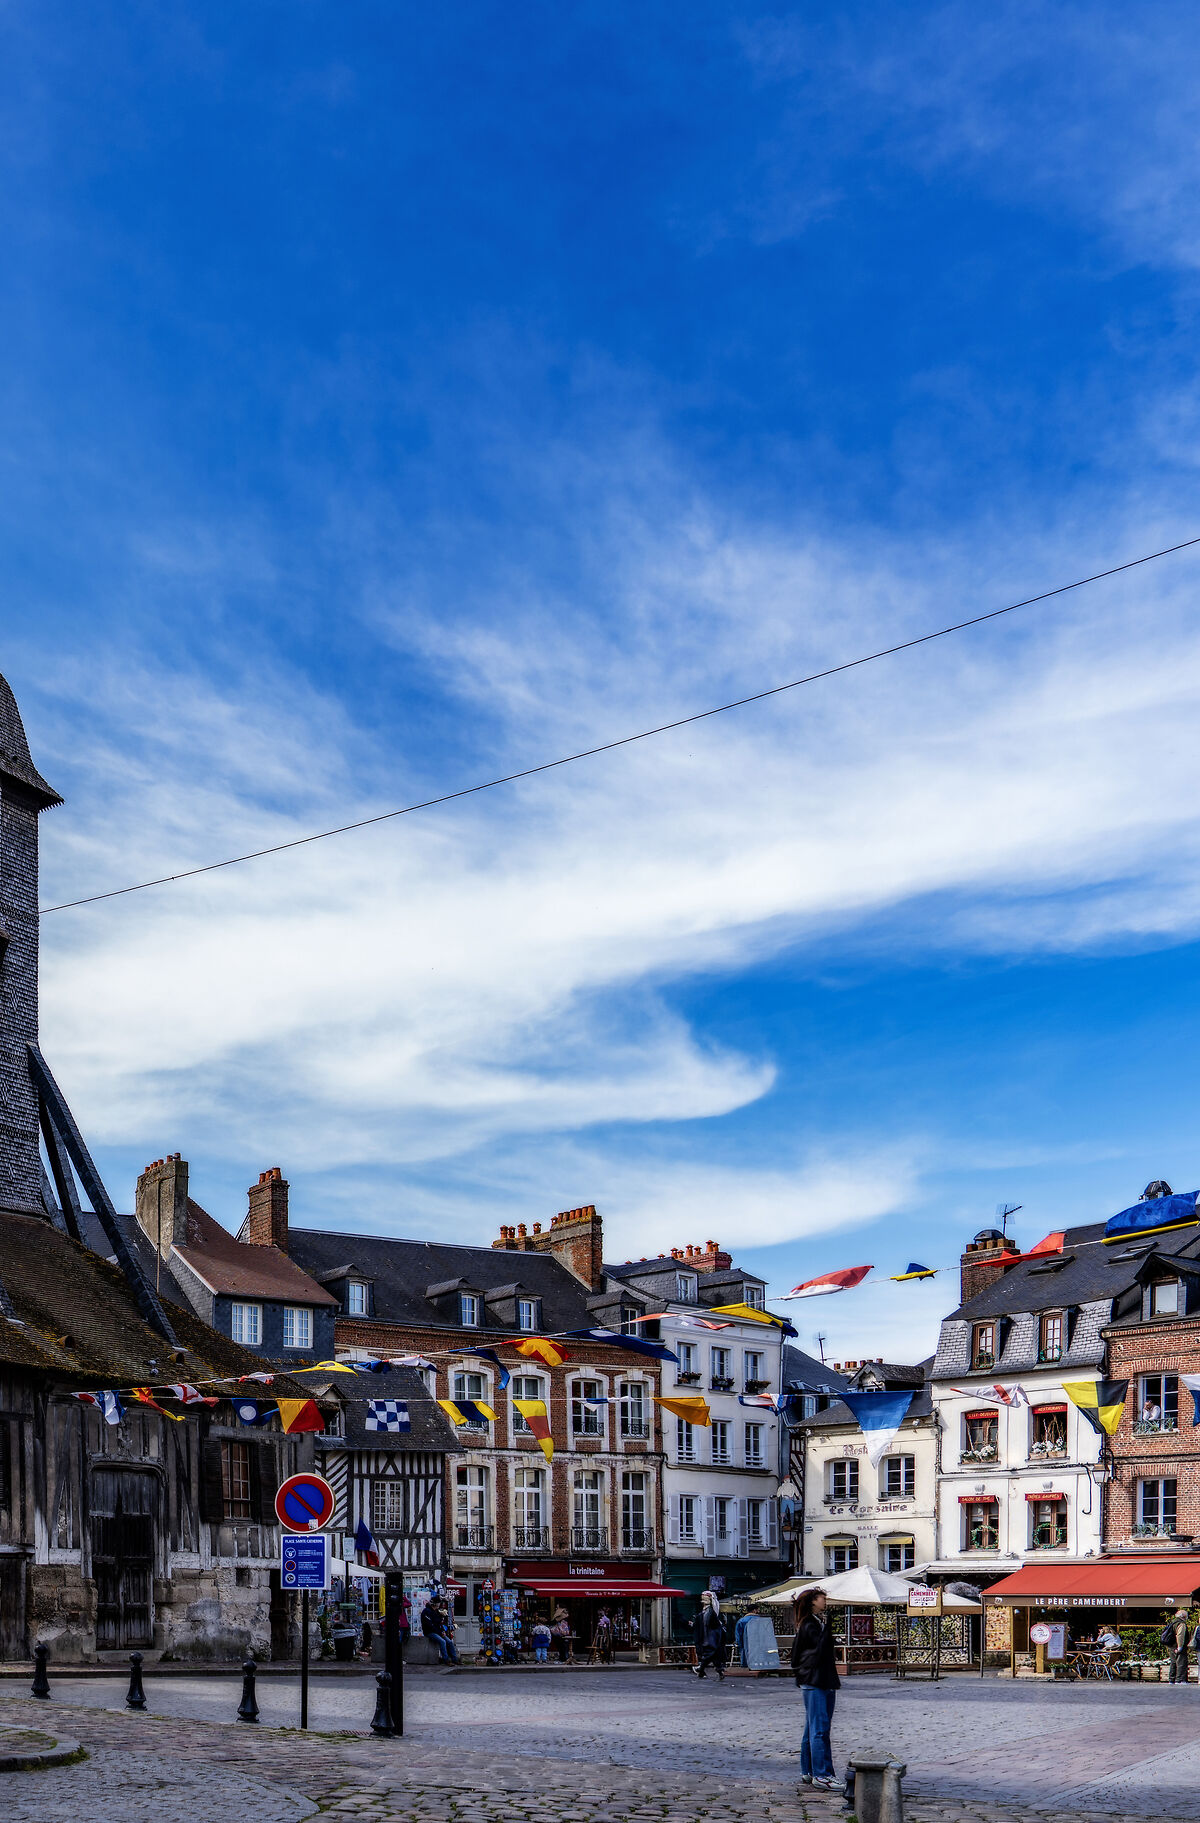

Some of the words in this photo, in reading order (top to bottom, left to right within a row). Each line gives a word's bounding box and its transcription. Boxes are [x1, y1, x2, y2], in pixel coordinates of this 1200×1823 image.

[569, 1563, 576, 1575] la
[576, 1566, 605, 1576] trinitaine
[1047, 1597, 1069, 1606] PÈRE
[1072, 1598, 1126, 1606] CAMEMBERT
